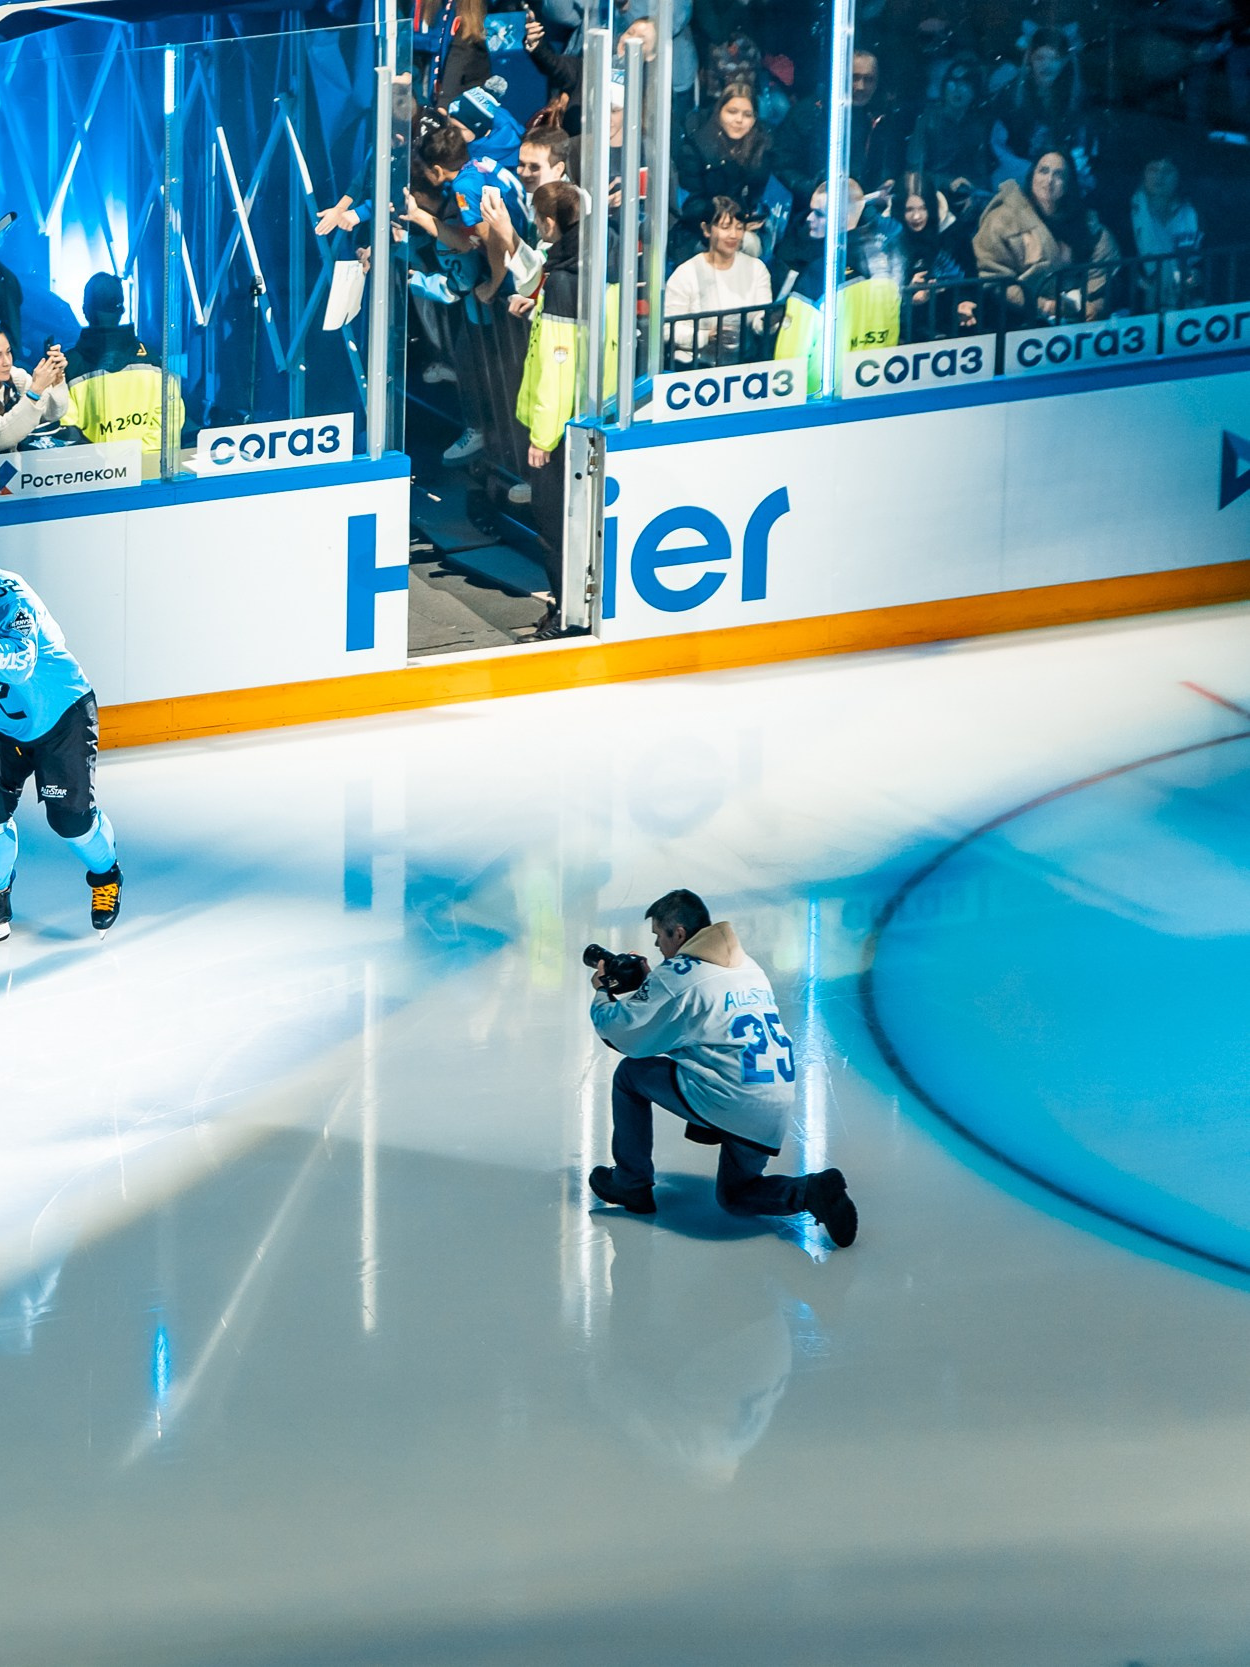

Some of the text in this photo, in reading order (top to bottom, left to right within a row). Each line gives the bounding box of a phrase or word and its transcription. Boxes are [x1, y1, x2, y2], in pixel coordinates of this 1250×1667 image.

[855, 346, 983, 388] согаз
[1017, 325, 1146, 368] согаз
[666, 369, 794, 410] согаз
[210, 425, 340, 465] согаз
[21, 467, 127, 489] Ростелеком
[730, 1013, 796, 1084] 25
